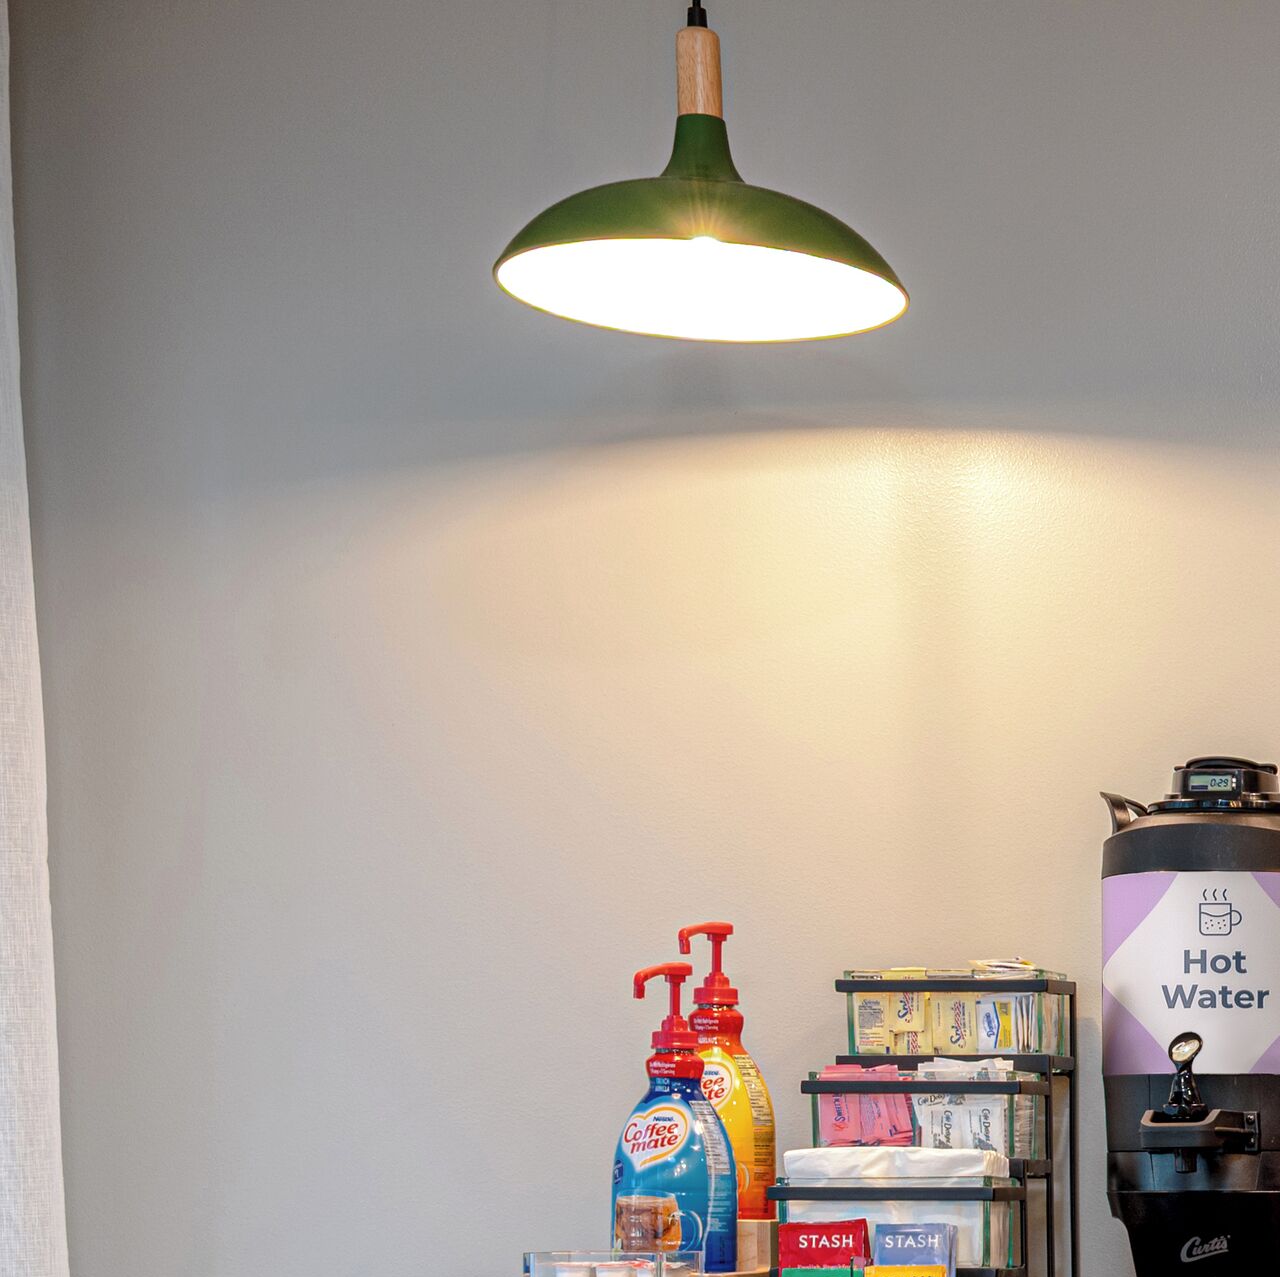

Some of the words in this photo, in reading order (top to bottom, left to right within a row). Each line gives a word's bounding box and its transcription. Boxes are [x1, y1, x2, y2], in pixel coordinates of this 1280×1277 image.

[1183, 949, 1247, 974] Hot
[1161, 984, 1270, 1009] Water
[624, 1122, 679, 1143] Coffee
[630, 1134, 679, 1154] mate
[798, 1234, 854, 1248] STASH
[884, 1234, 939, 1249] STASH
